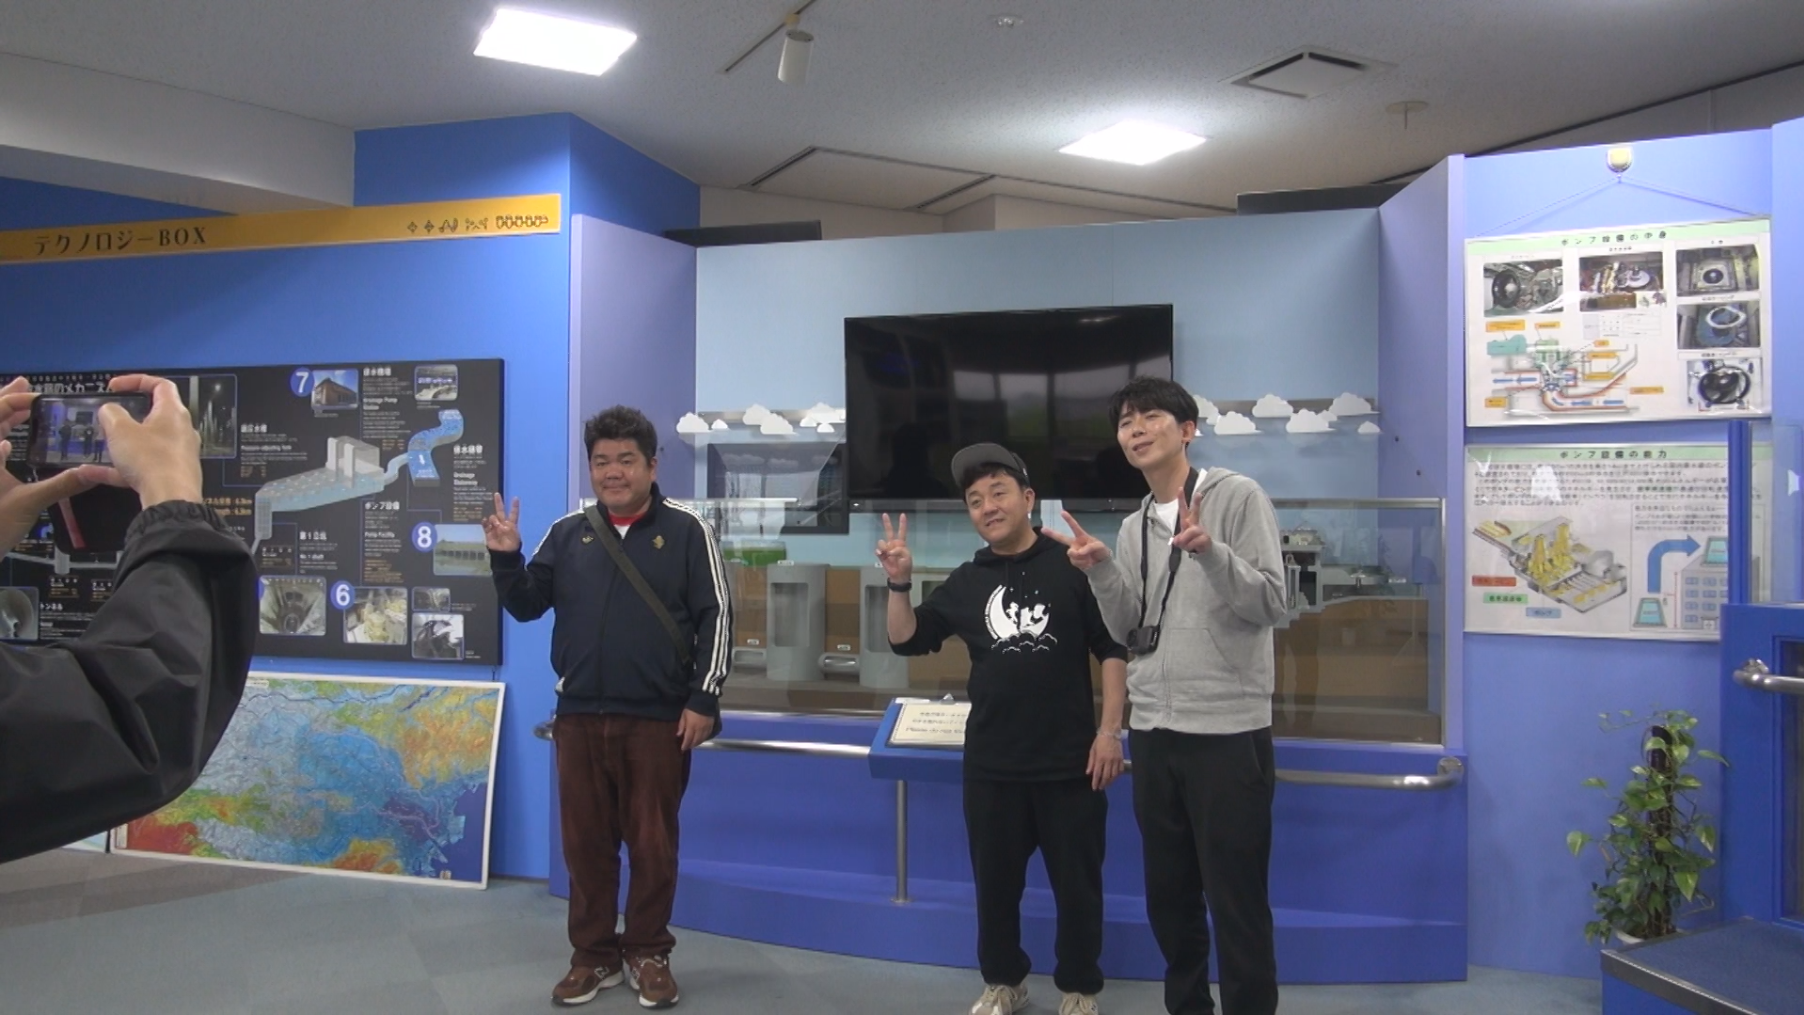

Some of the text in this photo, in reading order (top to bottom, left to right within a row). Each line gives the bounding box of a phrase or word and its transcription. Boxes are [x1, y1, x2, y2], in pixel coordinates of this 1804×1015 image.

[35, 227, 206, 255] テクノロジーBOX
[295, 371, 309, 393] 7
[1560, 448, 1667, 460] ポンプ設備の能力
[416, 525, 433, 548] 8
[335, 583, 351, 606] 6
